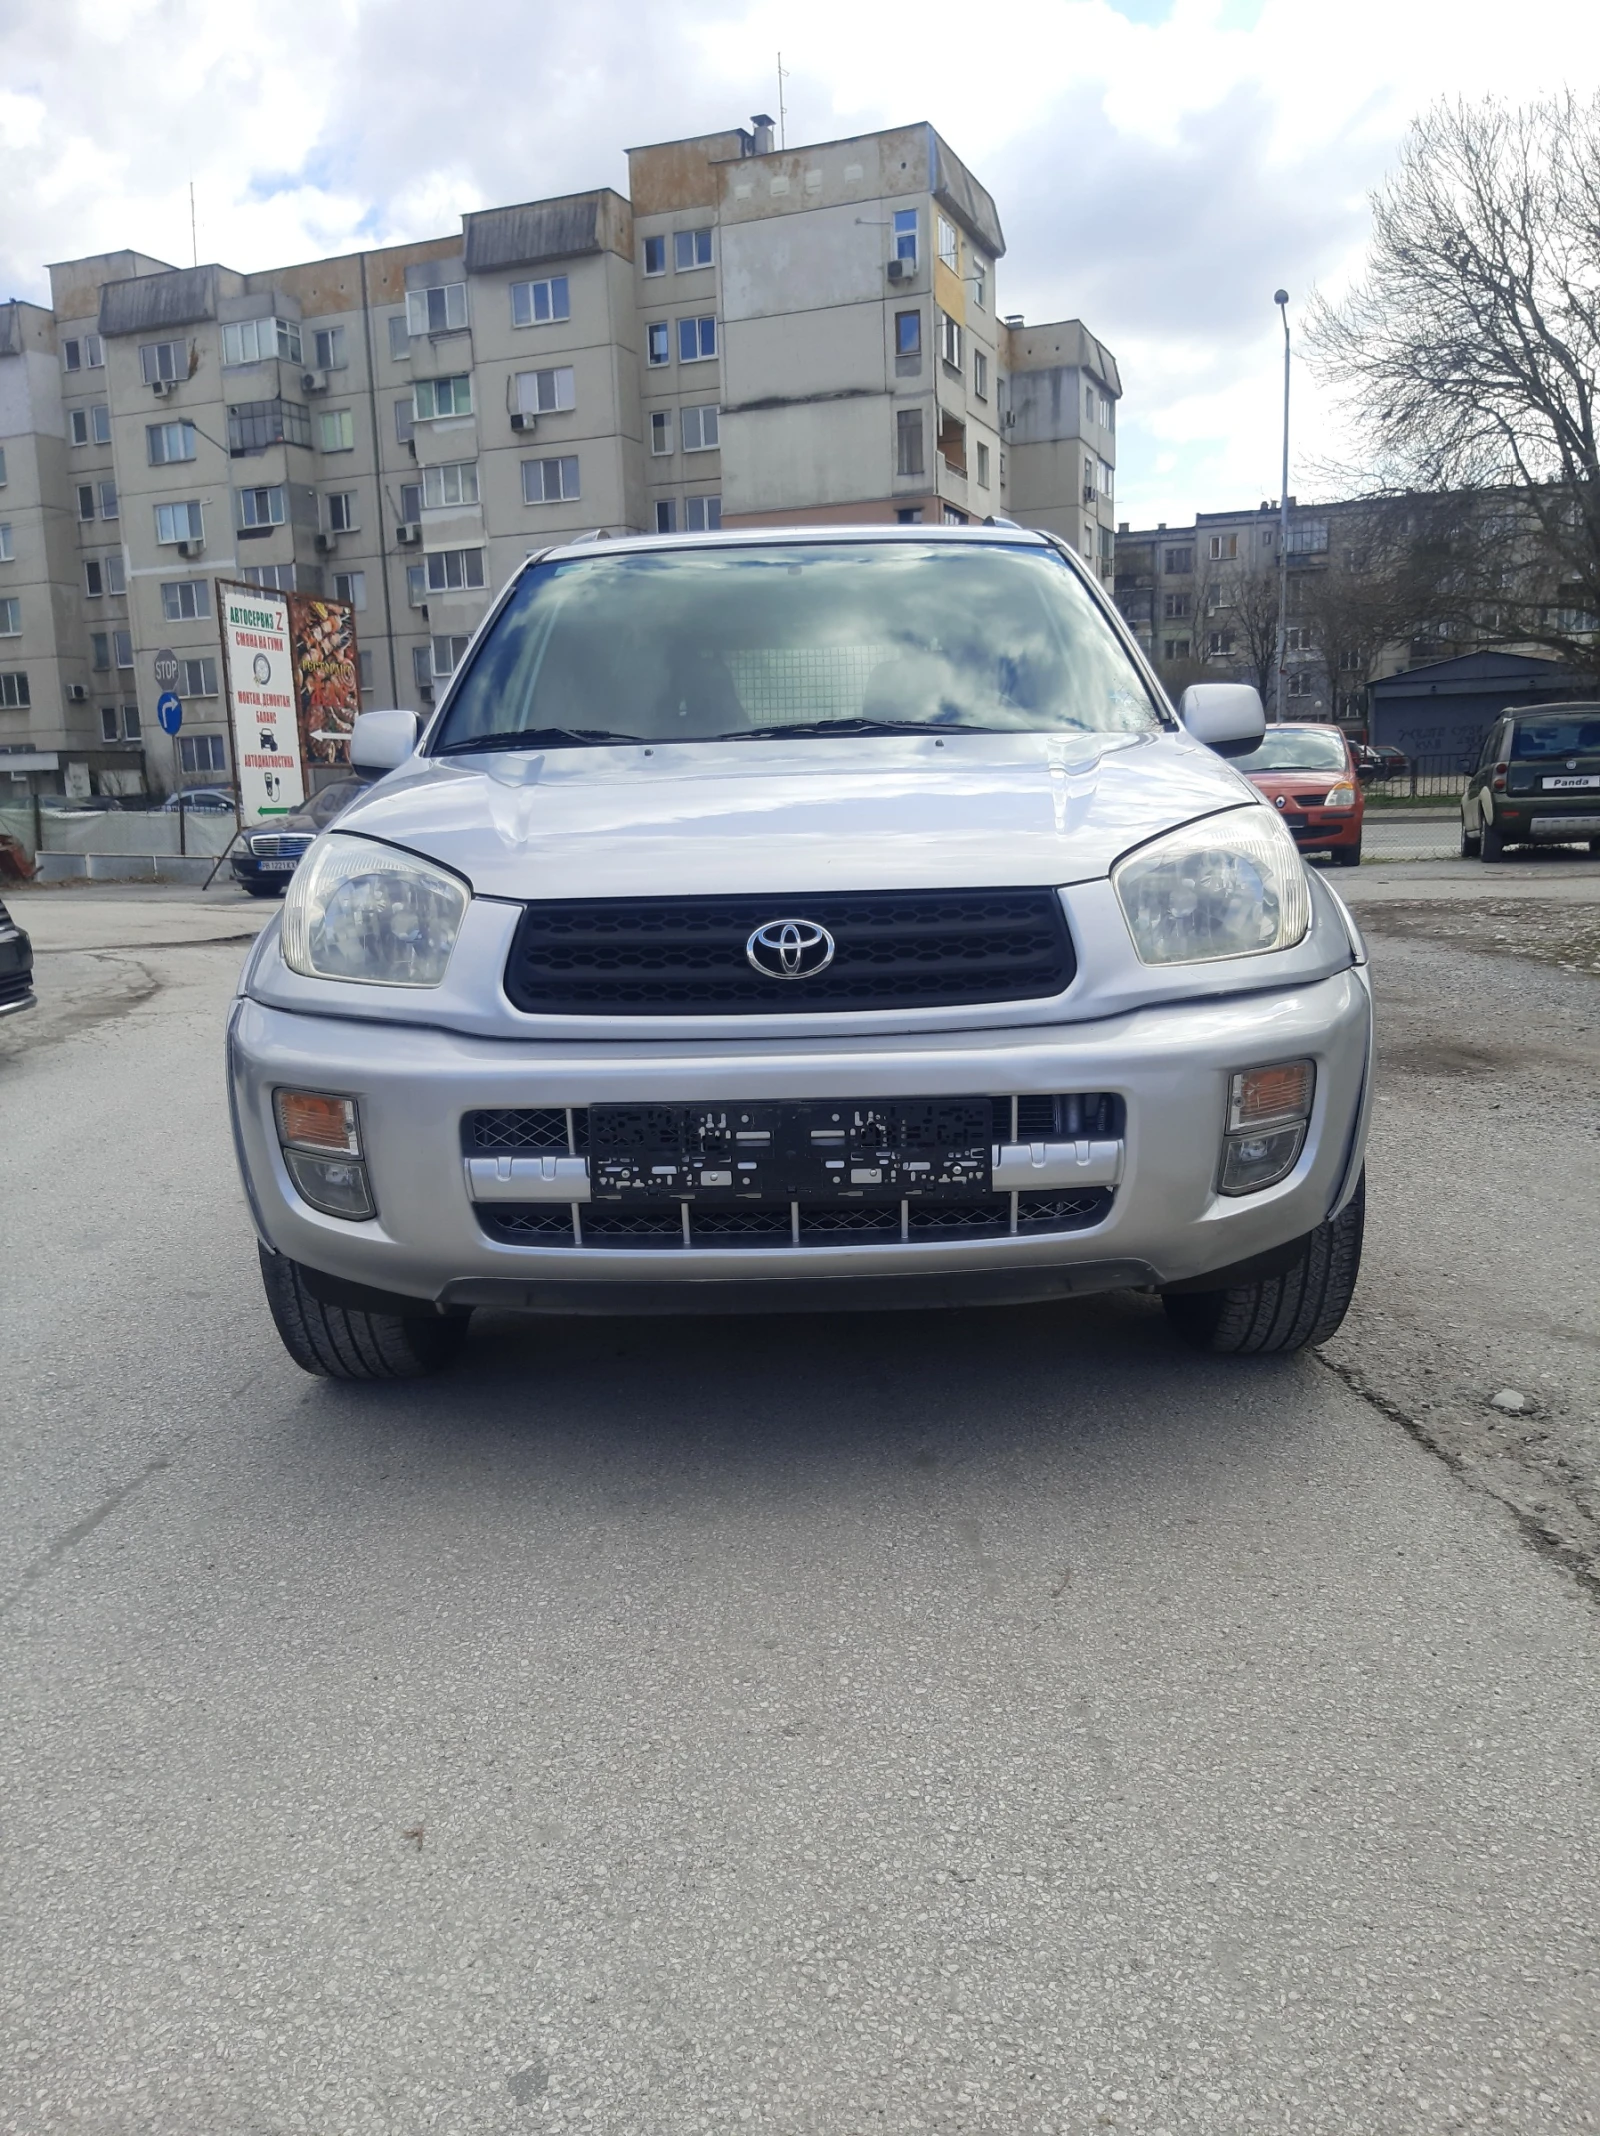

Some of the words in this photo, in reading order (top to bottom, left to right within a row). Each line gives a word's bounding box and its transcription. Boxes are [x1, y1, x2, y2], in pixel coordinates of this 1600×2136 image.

[230, 606, 274, 630] АВТОСЕРВИЗ
[275, 611, 284, 632] Z
[235, 631, 258, 649] СМЯНА
[258, 635, 267, 650] НА
[267, 636, 284, 652] ГУМИ
[155, 660, 177, 680] STOP
[262, 693, 291, 708] ДЕМОНТАЖ
[255, 710, 277, 725] БАЛАНС
[244, 754, 294, 769] АВТОДИАГНОСТИКА
[1553, 778, 1589, 787] Panda
